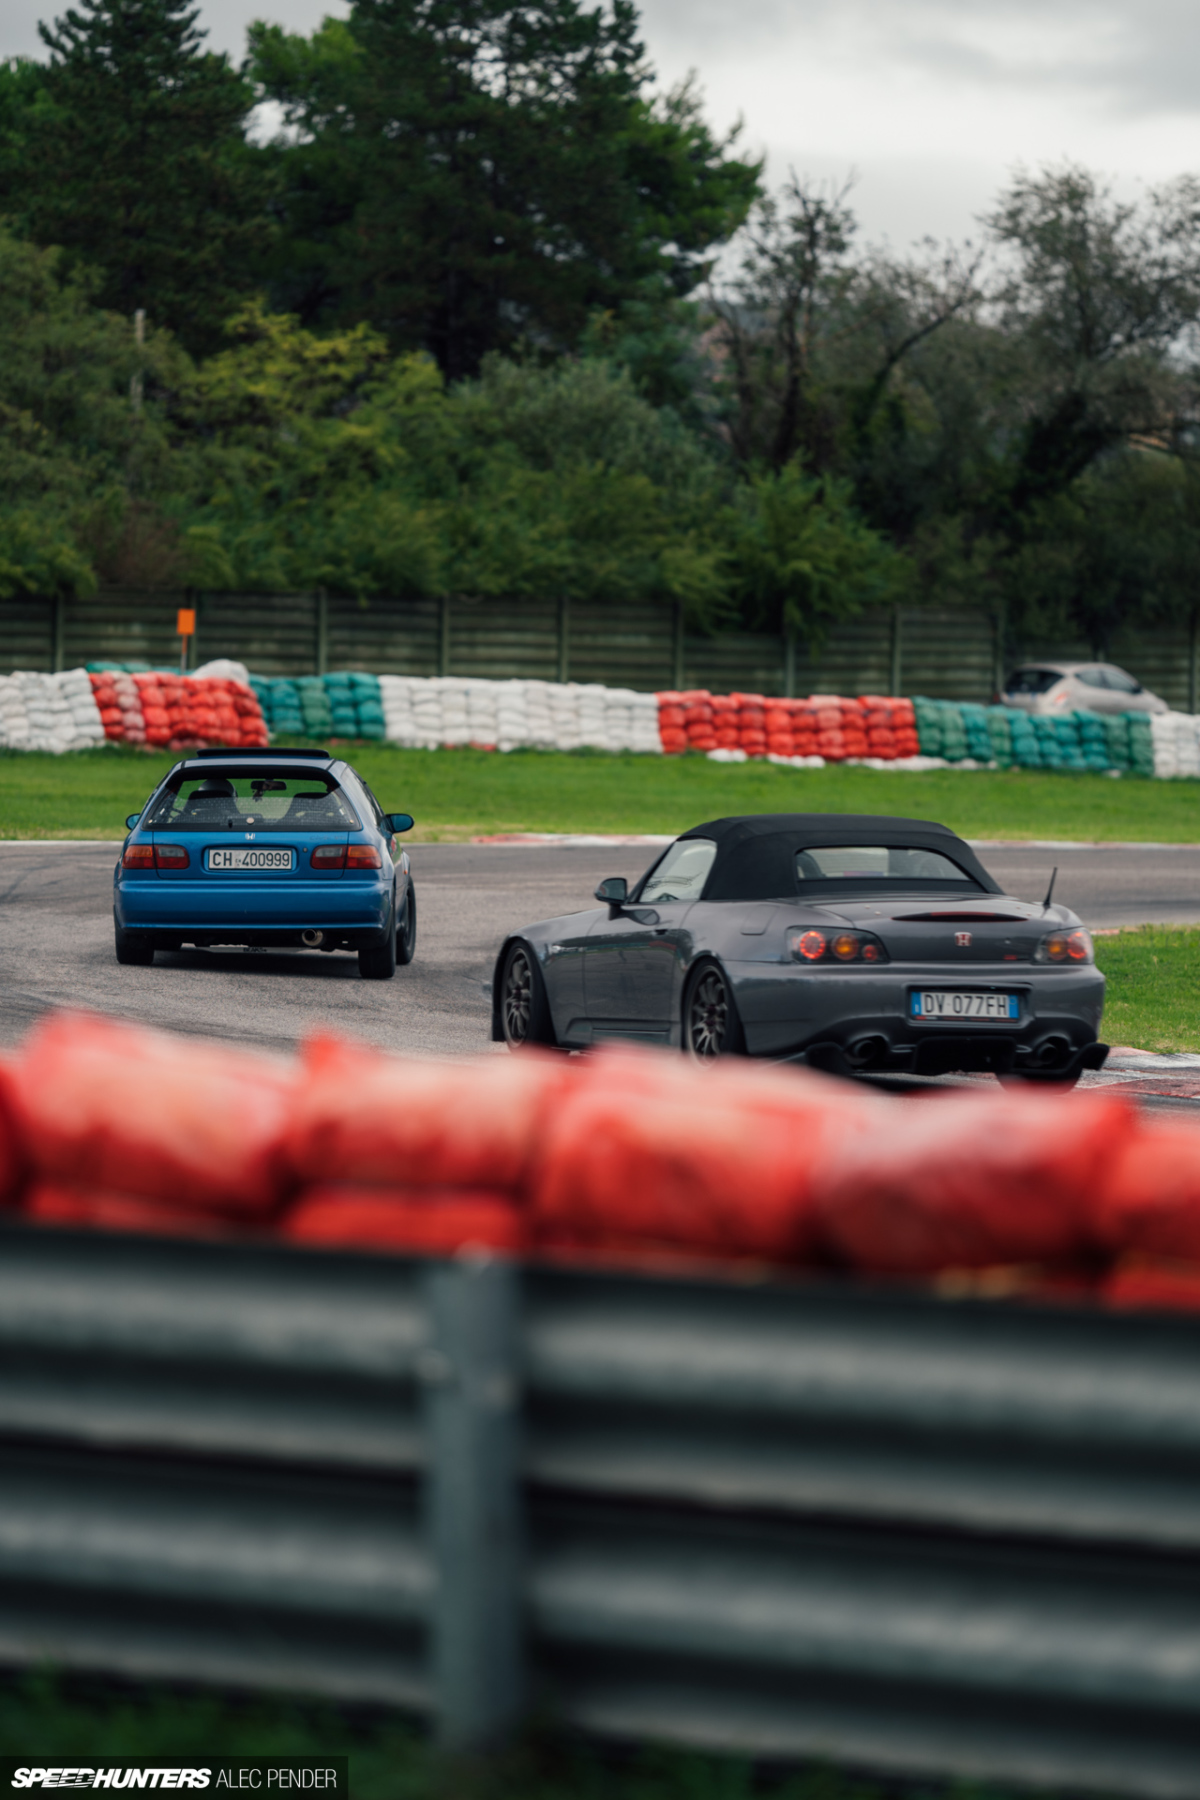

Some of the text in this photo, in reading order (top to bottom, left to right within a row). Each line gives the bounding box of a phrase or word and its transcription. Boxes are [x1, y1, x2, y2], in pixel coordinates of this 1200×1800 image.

[212, 852, 232, 867] CH
[242, 852, 290, 867] 400999
[924, 994, 945, 1013] DV
[952, 995, 1007, 1015] 077FH
